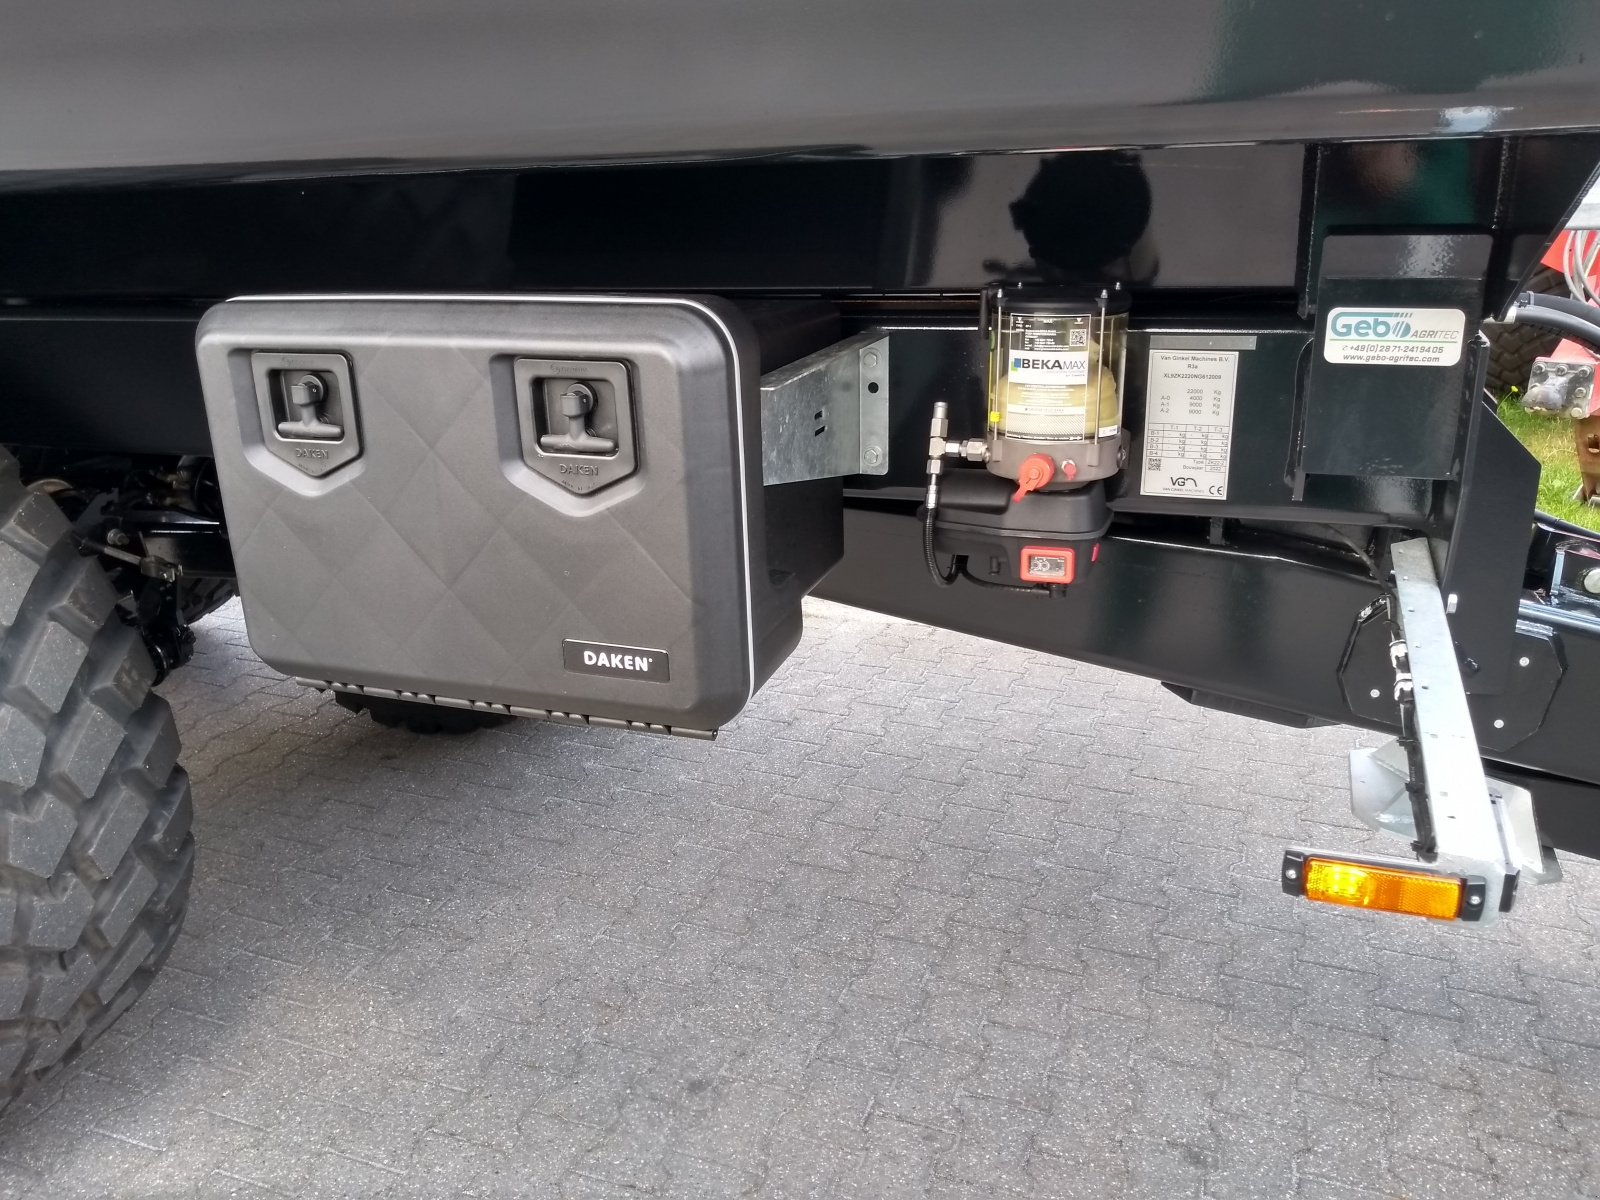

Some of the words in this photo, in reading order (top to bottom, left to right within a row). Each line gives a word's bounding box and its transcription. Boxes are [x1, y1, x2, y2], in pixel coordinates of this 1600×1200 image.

[1331, 312, 1411, 338] Gebo
[1411, 330, 1459, 339] AGRITEC
[1343, 354, 1440, 363] www.gebo-agritec.com
[296, 448, 329, 460] DAKEN
[559, 463, 599, 476] DAKEN
[583, 650, 649, 672] DAKEN
